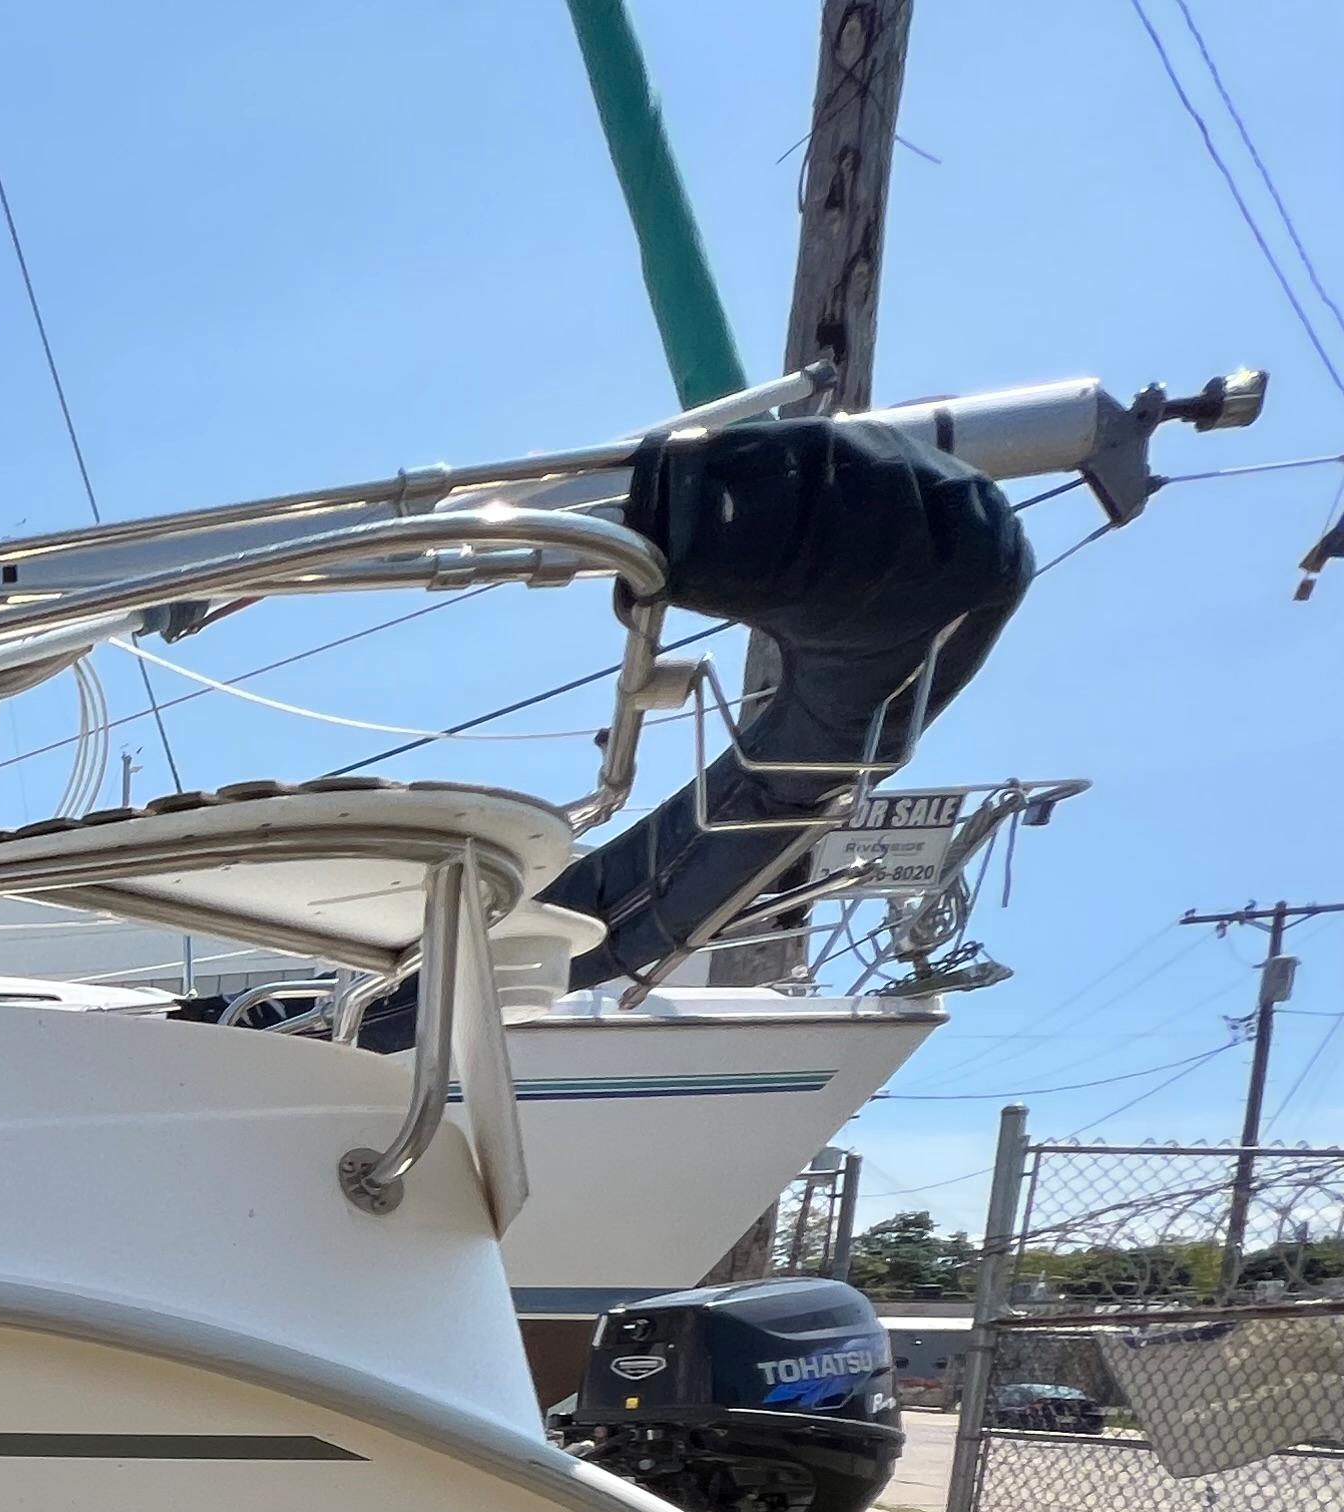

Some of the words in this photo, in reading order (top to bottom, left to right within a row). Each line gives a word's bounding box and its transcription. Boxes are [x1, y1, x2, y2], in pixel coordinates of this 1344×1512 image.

[847, 799, 889, 829] OR
[891, 797, 960, 828] SALE
[756, 1350, 873, 1386] TOHATSU
